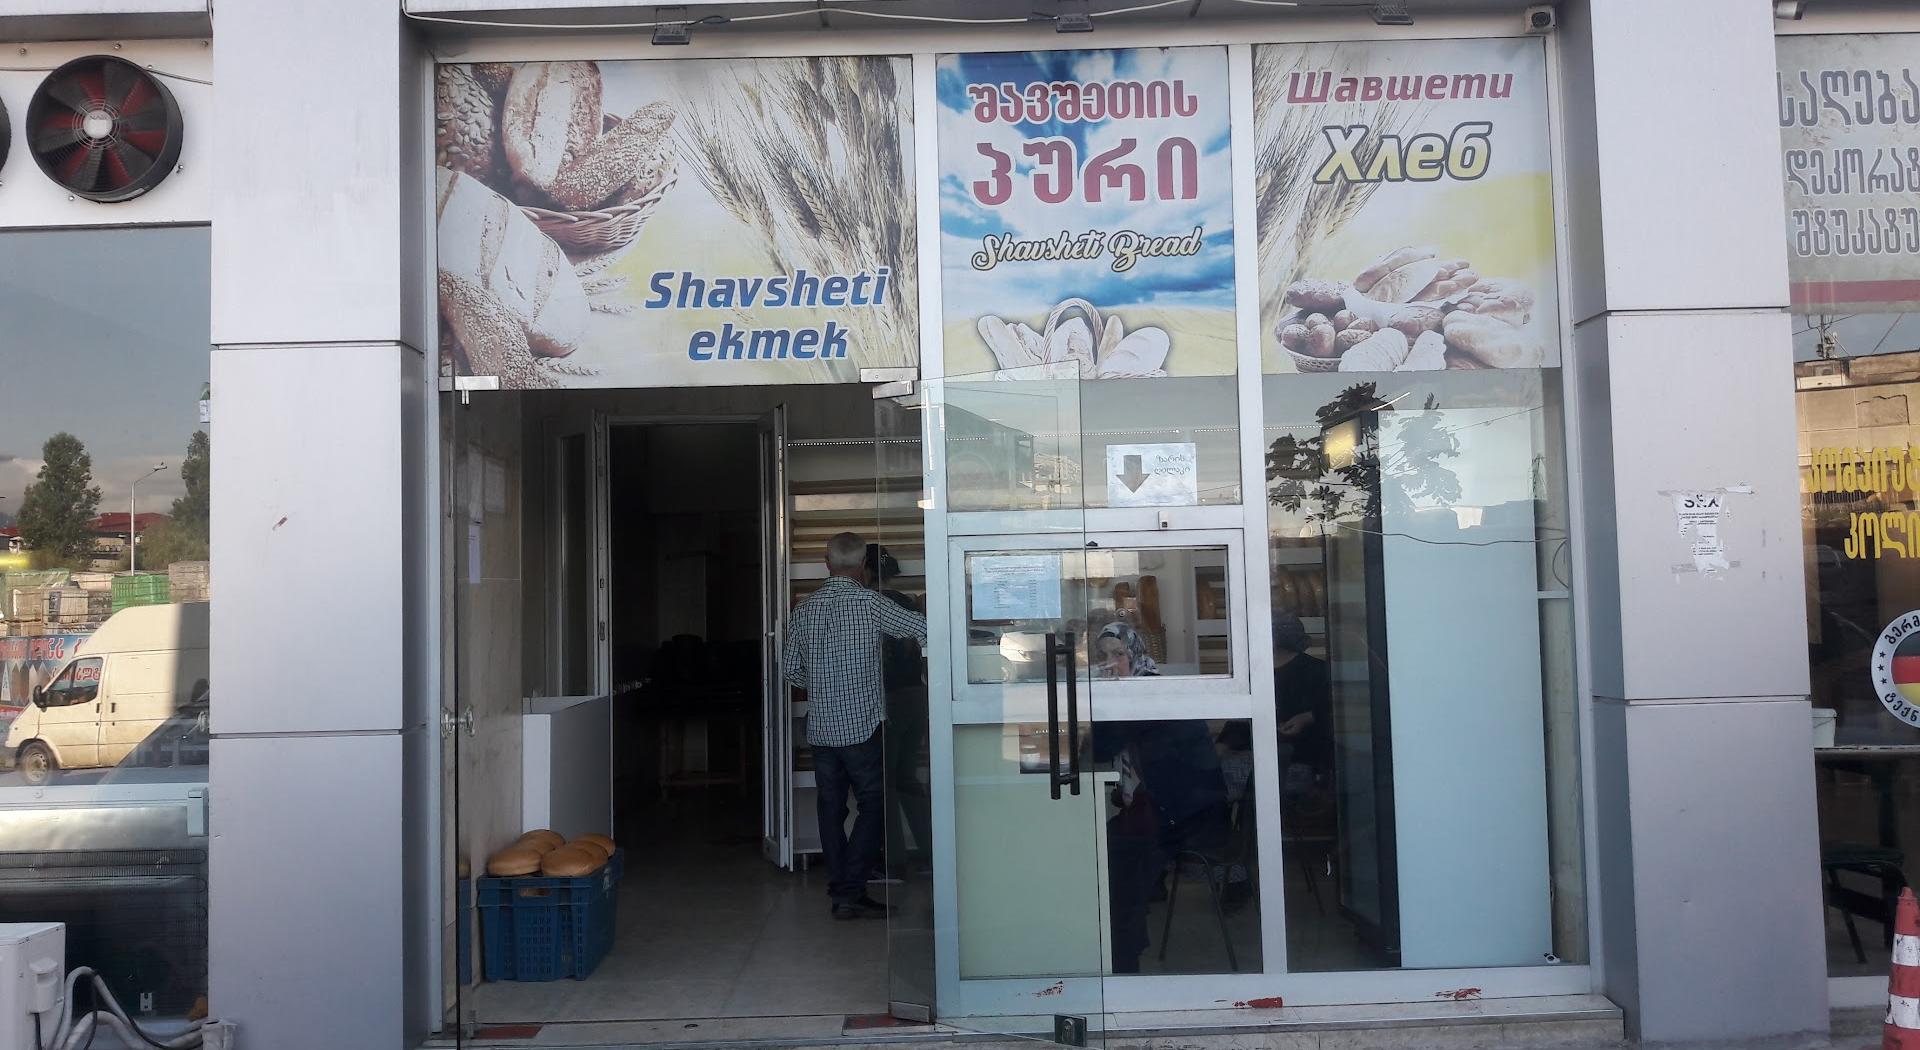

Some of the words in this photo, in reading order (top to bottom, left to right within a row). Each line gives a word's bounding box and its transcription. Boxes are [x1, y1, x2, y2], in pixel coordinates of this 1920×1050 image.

[968, 79, 1198, 123] შავშეთის
[1287, 71, 1513, 103] Шавшети
[973, 136, 1198, 205] პური
[1312, 121, 1493, 184] Хлеб
[971, 229, 1105, 271] Shavsheti
[1108, 226, 1203, 272] Bread
[645, 267, 888, 309] Shavsheti
[688, 321, 849, 361] ekmek
